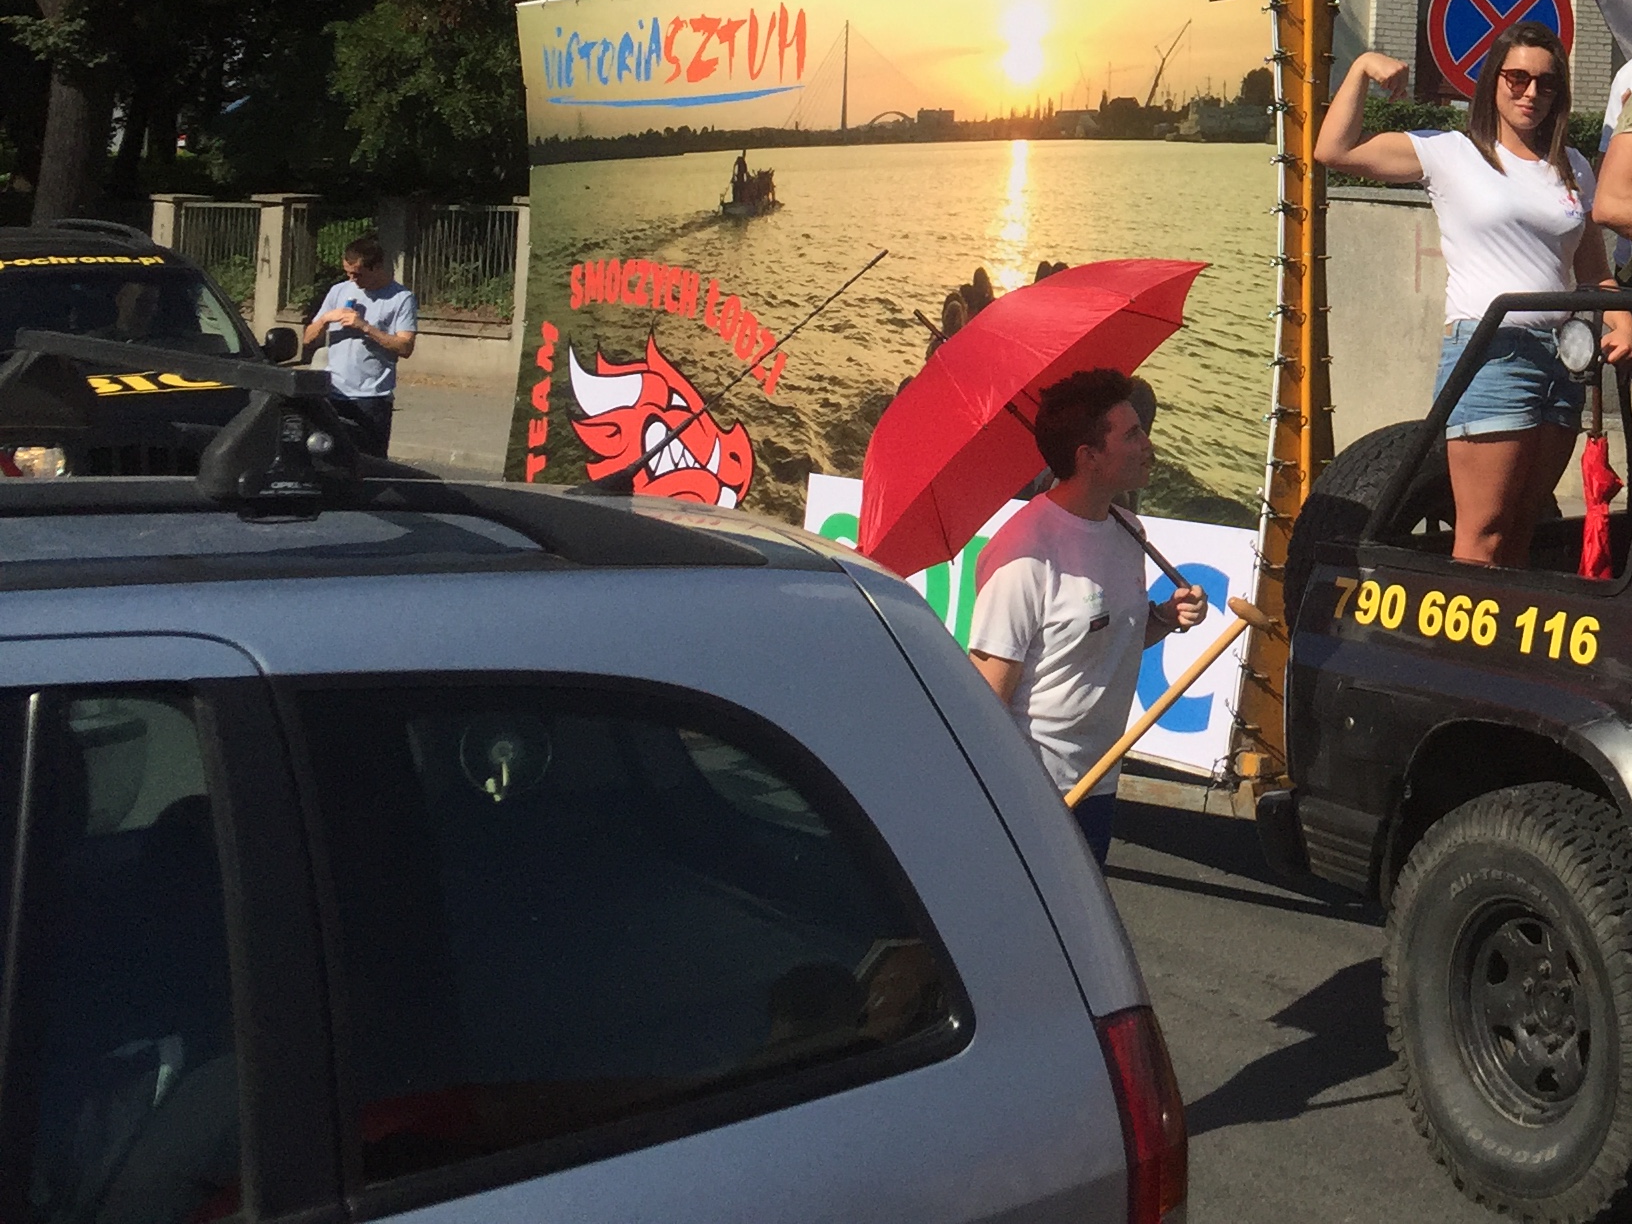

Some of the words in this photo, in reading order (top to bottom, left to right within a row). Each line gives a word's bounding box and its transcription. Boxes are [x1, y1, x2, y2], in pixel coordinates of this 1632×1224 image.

[664, 2, 806, 84] SZTUM
[570, 258, 699, 319] SMOCZYCH
[526, 321, 559, 483] TEAM
[1334, 577, 1407, 629] 790
[1418, 591, 1499, 646] 666
[1515, 606, 1599, 665] 116
